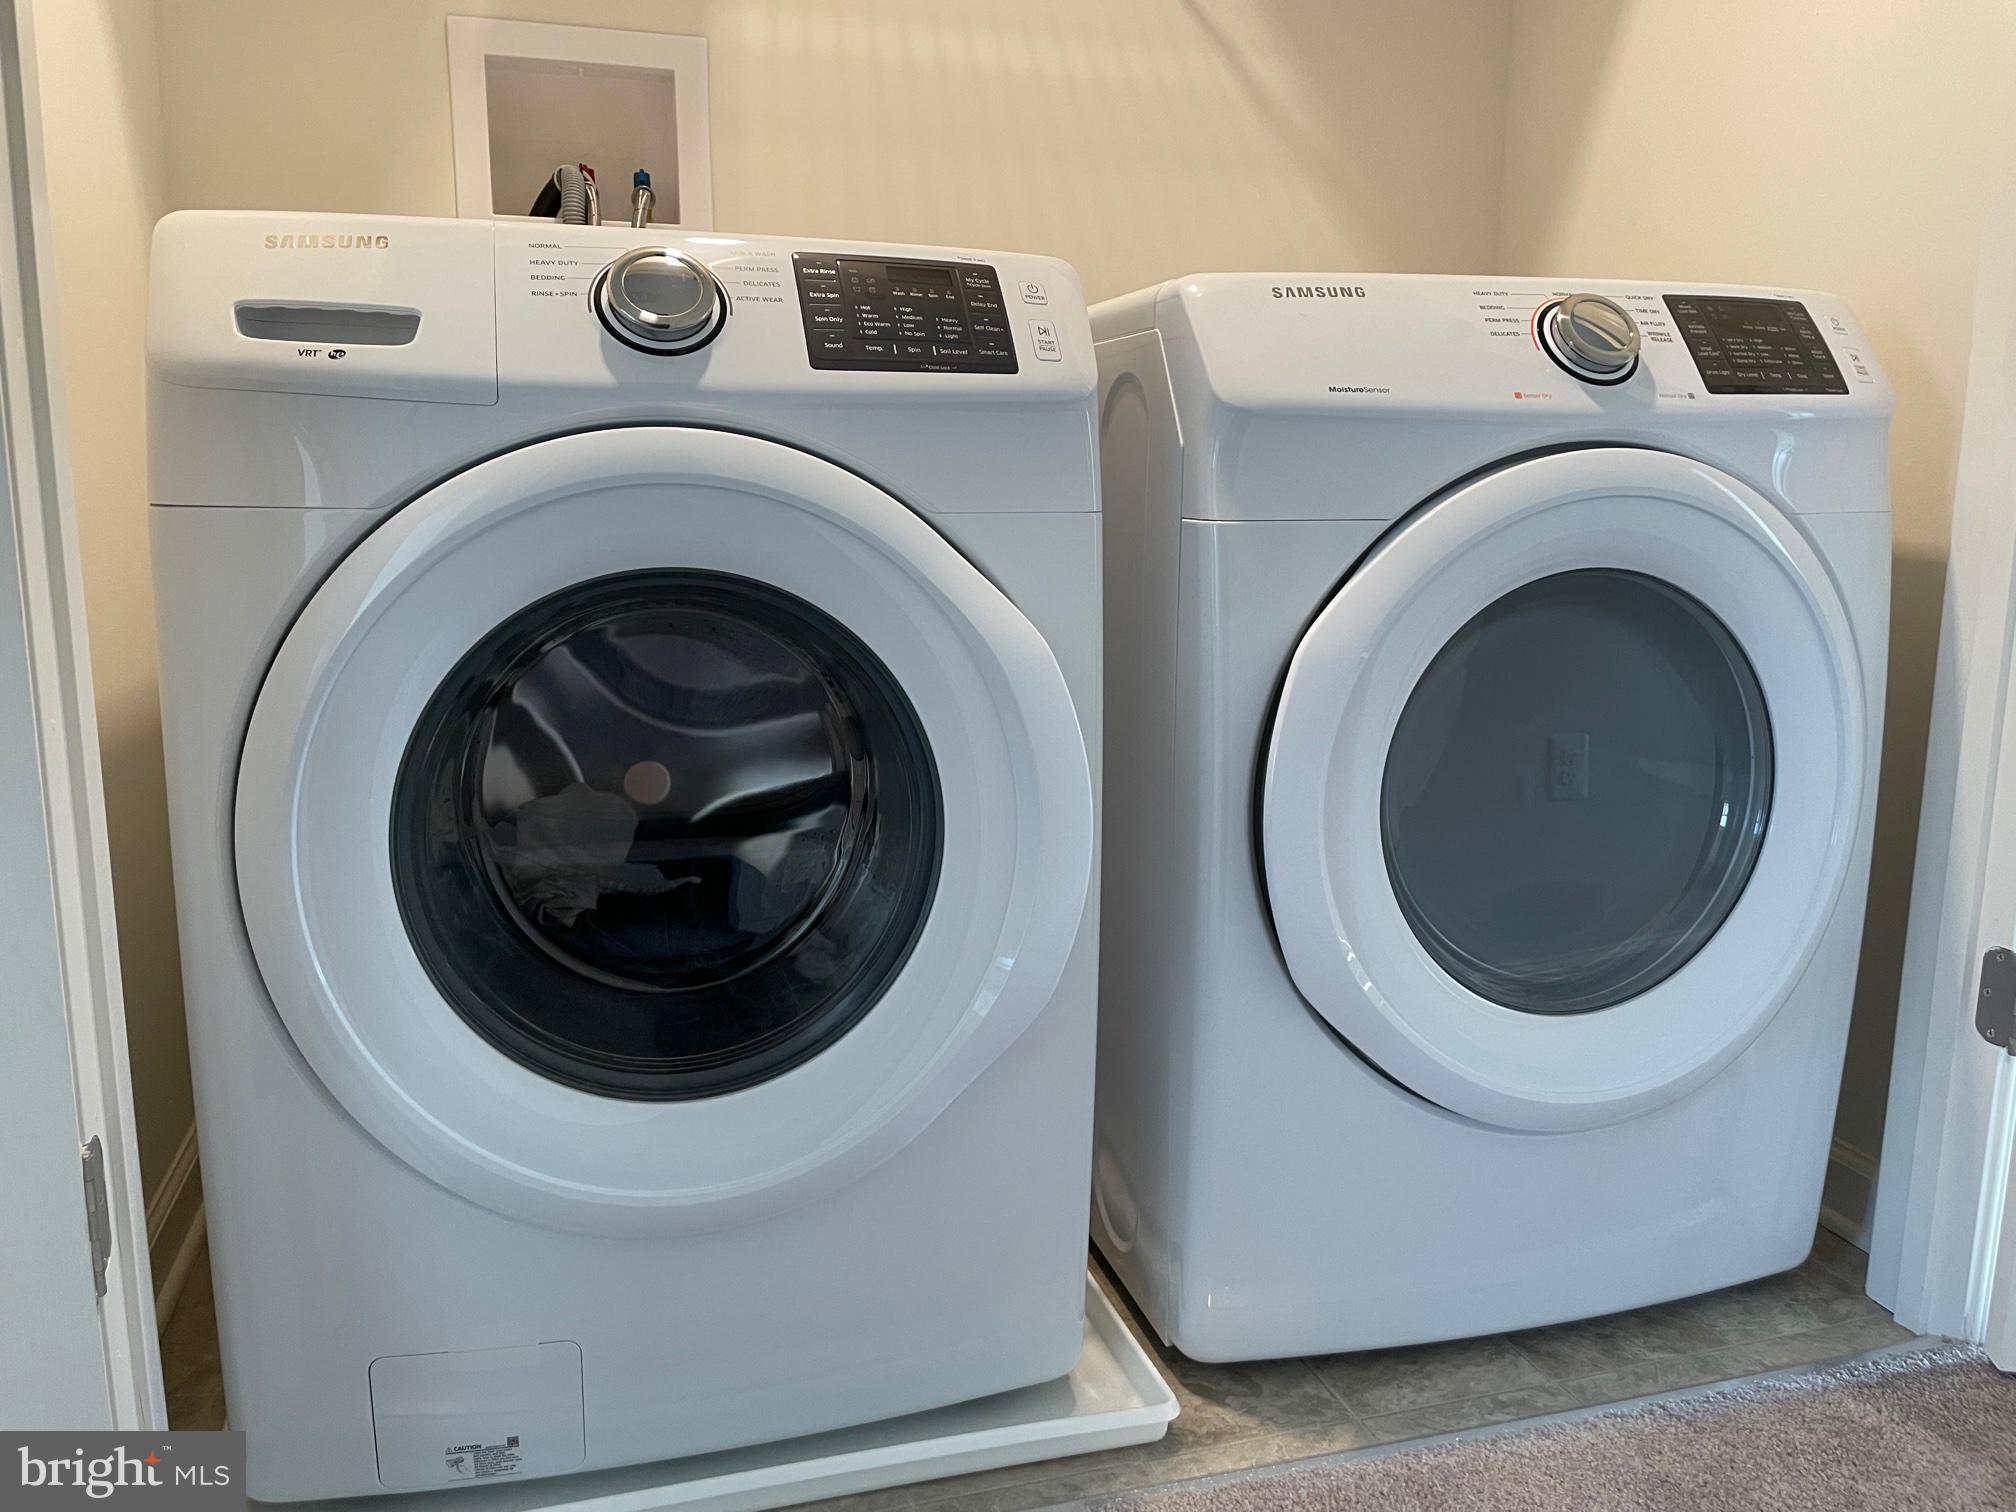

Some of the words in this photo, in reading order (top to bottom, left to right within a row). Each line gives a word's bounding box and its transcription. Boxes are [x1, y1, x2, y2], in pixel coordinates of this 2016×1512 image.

[264, 234, 390, 250] SAMSUNG
[743, 280, 781, 288] DELICATES
[1272, 286, 1366, 299] SAMSUNG
[1329, 386, 1390, 394] MoistureSensor
